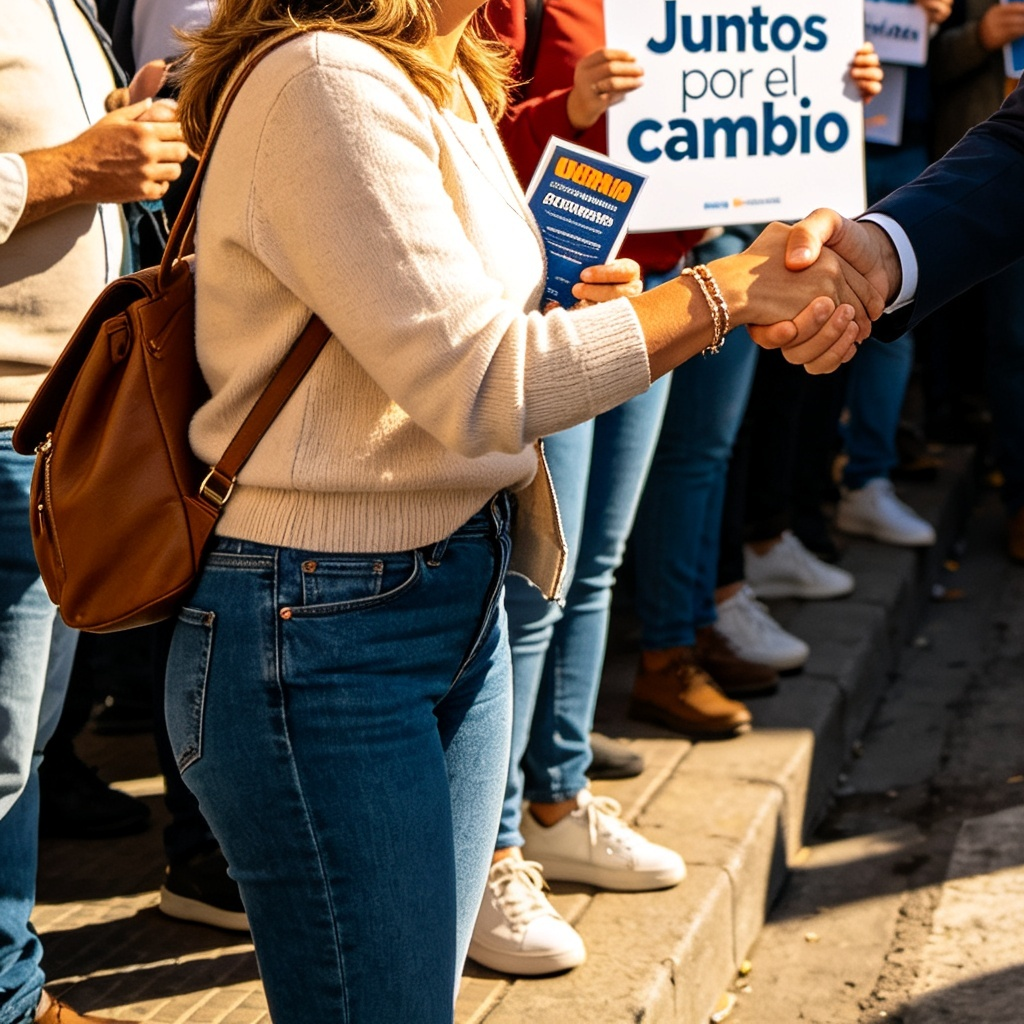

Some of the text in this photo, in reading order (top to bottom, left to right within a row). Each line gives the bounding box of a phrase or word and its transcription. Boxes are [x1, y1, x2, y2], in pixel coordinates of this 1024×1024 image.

[646, 0, 828, 54] Juntos
[682, 55, 797, 113] por el
[627, 97, 849, 163] cambio
